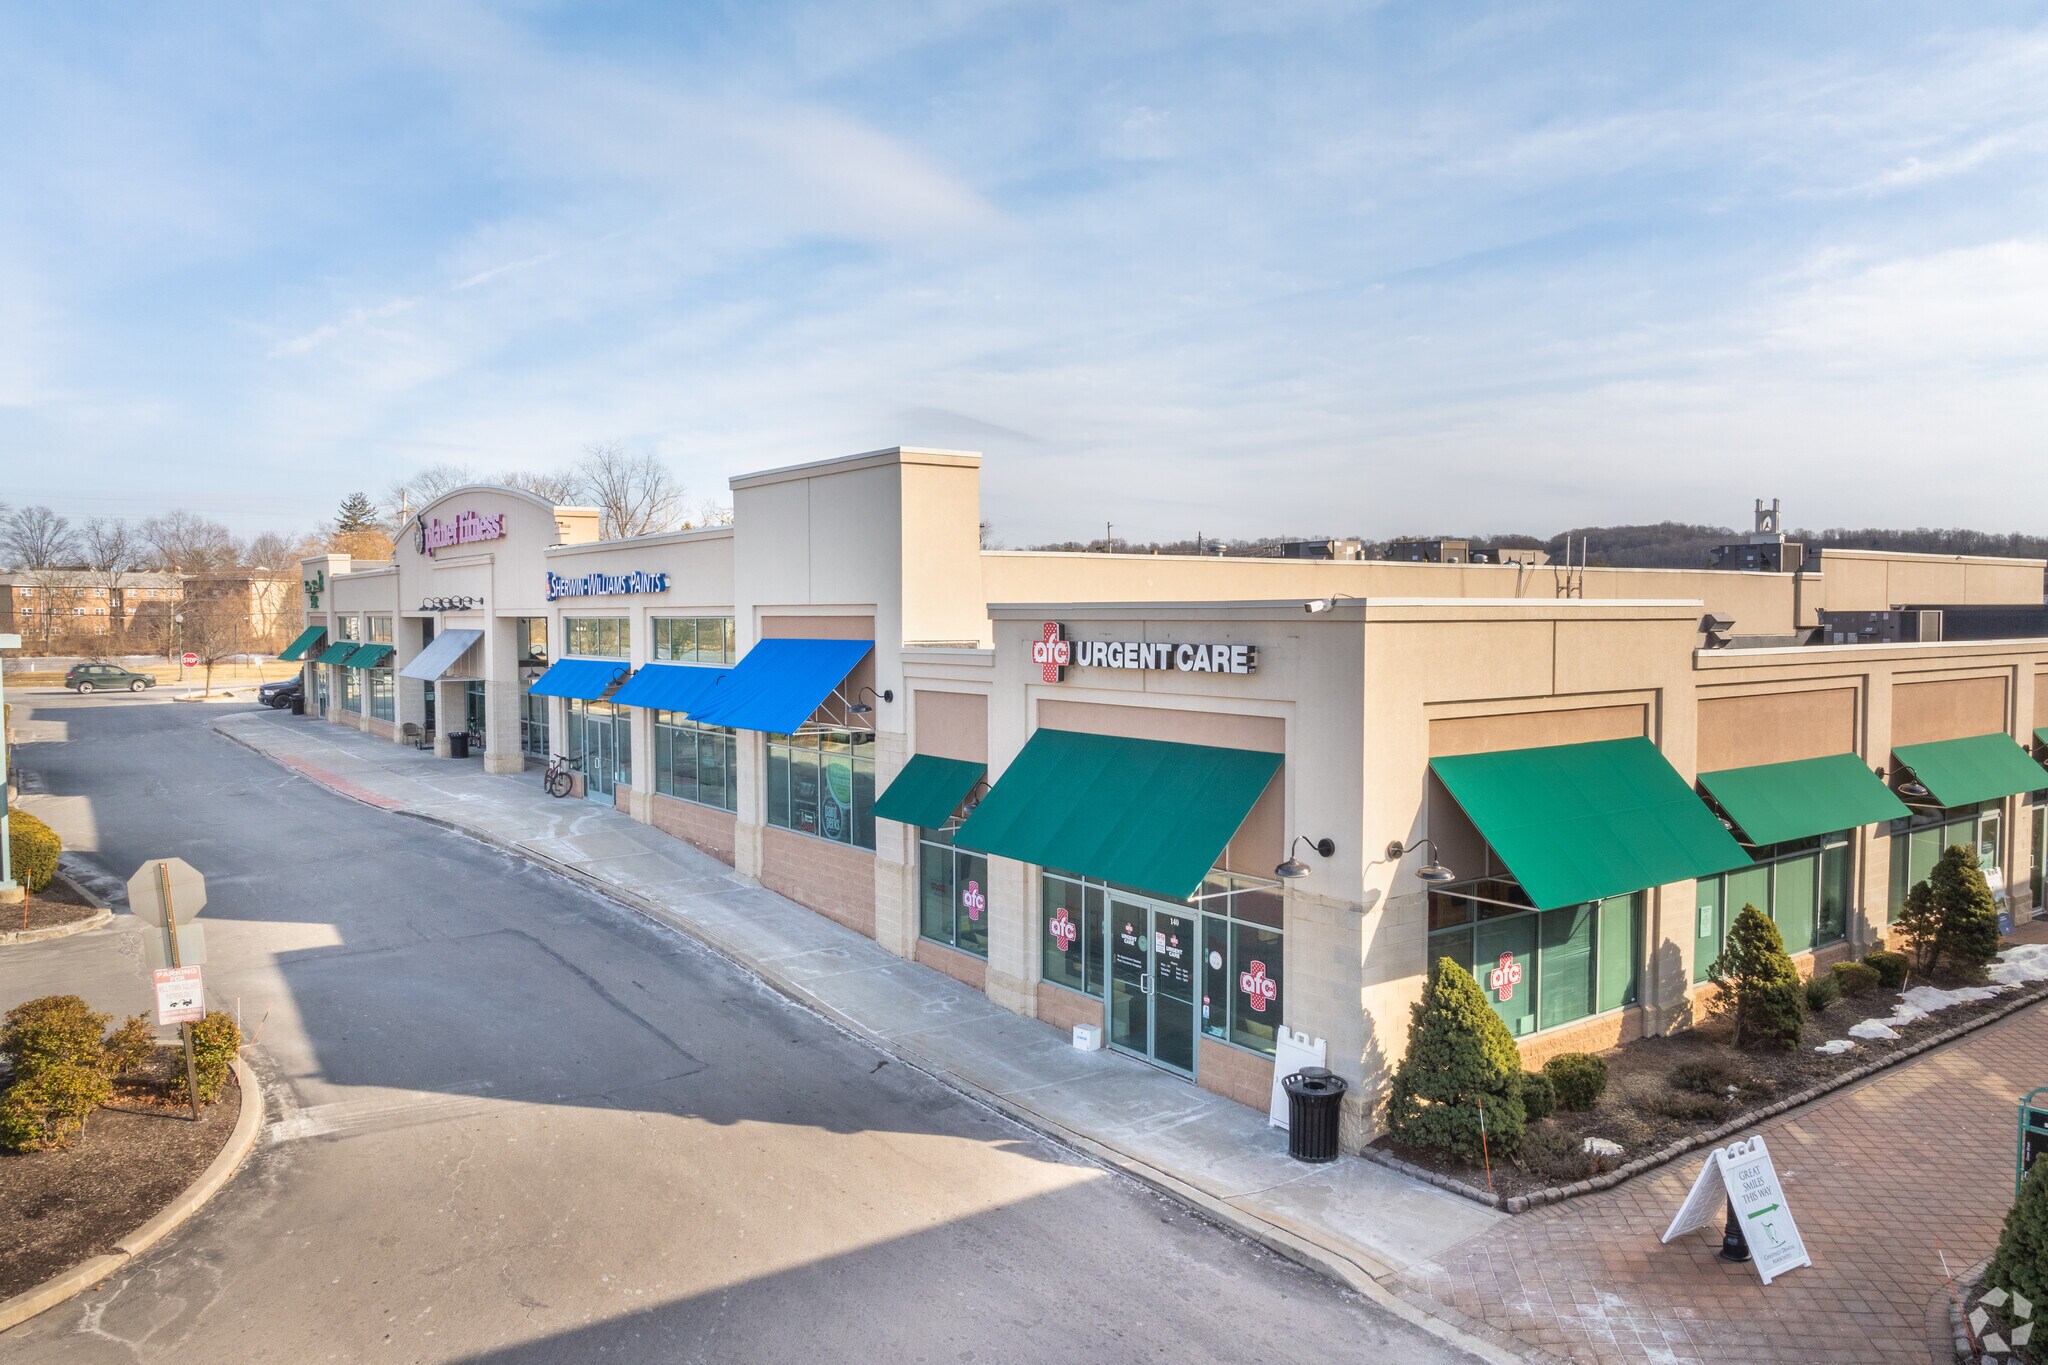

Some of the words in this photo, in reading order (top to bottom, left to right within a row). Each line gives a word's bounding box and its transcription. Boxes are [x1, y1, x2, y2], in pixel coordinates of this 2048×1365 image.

[425, 519, 458, 557] planet
[459, 511, 501, 544] fitness
[551, 573, 626, 597] SHERWIN-WILLIAMS
[630, 571, 661, 594] PAINTS
[1034, 633, 1067, 664] afc
[1077, 640, 1172, 670] URGENT
[1177, 644, 1248, 674] CARE
[963, 889, 983, 909] afc
[1051, 917, 1075, 939] afc
[1170, 917, 1180, 927] 140
[156, 968, 198, 978] PARKING
[1491, 960, 1519, 986] afc
[1242, 971, 1274, 998] afc
[1739, 1165, 1761, 1181] GREAT
[1742, 1191, 1759, 1204] THIS
[1759, 1185, 1773, 1199] WAY
[1743, 1176, 1765, 1192] SMILES
